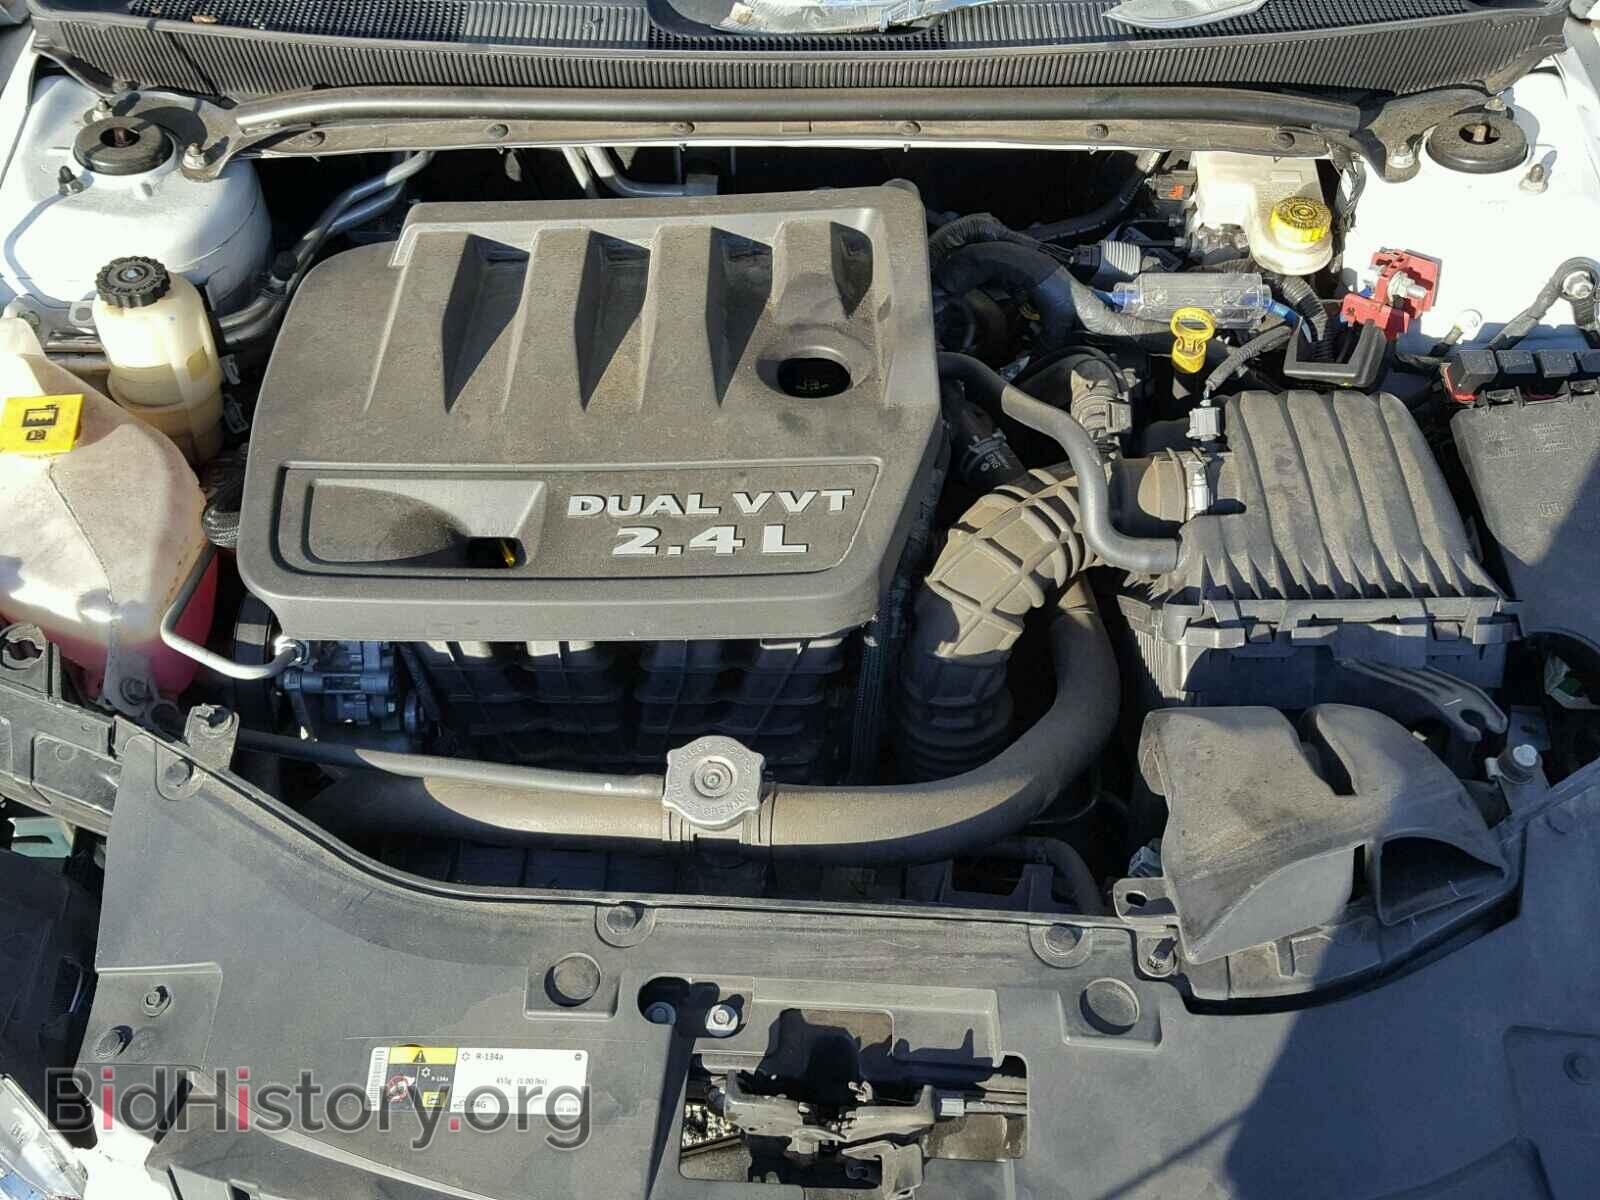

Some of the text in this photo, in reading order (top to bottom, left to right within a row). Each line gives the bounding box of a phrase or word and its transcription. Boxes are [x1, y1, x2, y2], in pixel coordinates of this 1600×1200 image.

[567, 488, 855, 517] DUAL VVT
[612, 523, 808, 556] 2.4 L
[476, 1052, 504, 1061] R-134a
